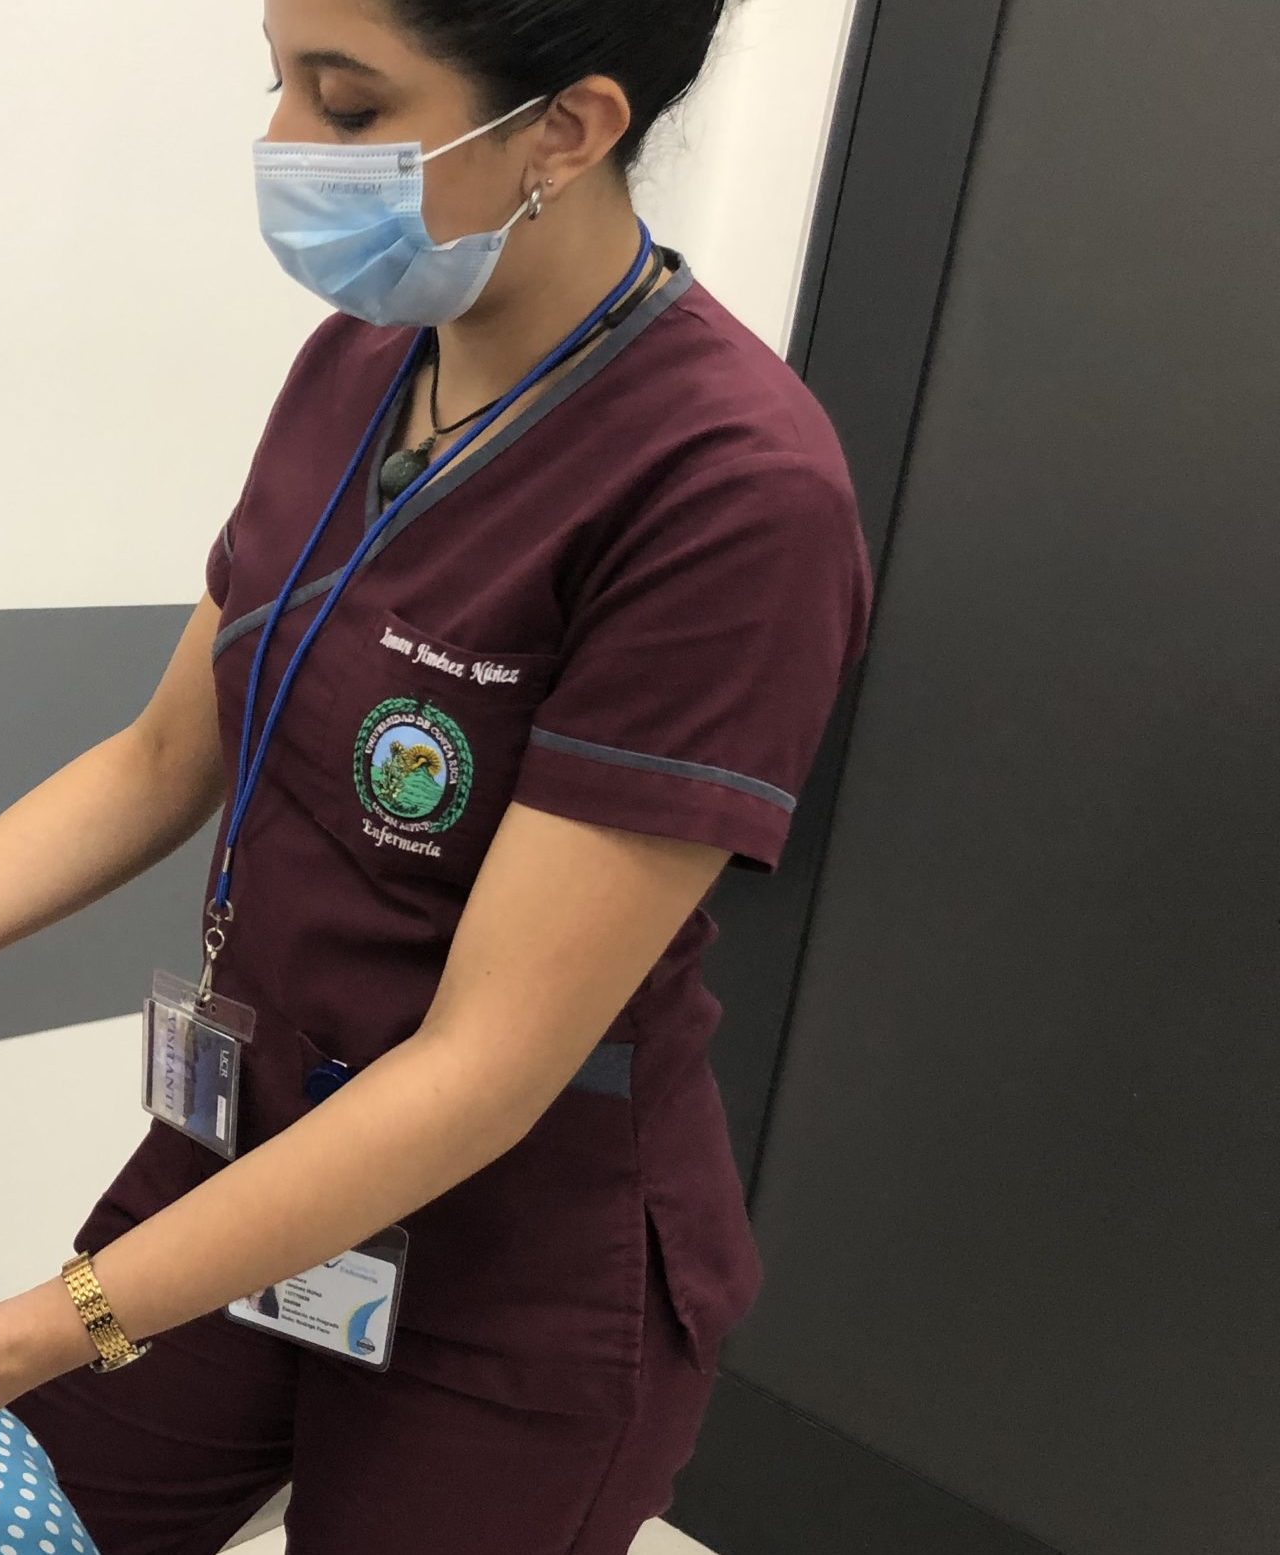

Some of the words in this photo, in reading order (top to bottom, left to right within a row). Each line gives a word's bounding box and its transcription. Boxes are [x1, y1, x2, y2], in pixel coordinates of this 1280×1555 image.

[412, 644, 464, 677] Jiménez
[470, 661, 520, 685] Núñez
[365, 714, 415, 754] UNIVERSIDAD
[415, 715, 431, 729] DE
[430, 726, 455, 759] COSTA
[448, 759, 458, 784] RICA
[362, 818, 441, 857] Enfermería
[221, 1050, 230, 1078] UCR
